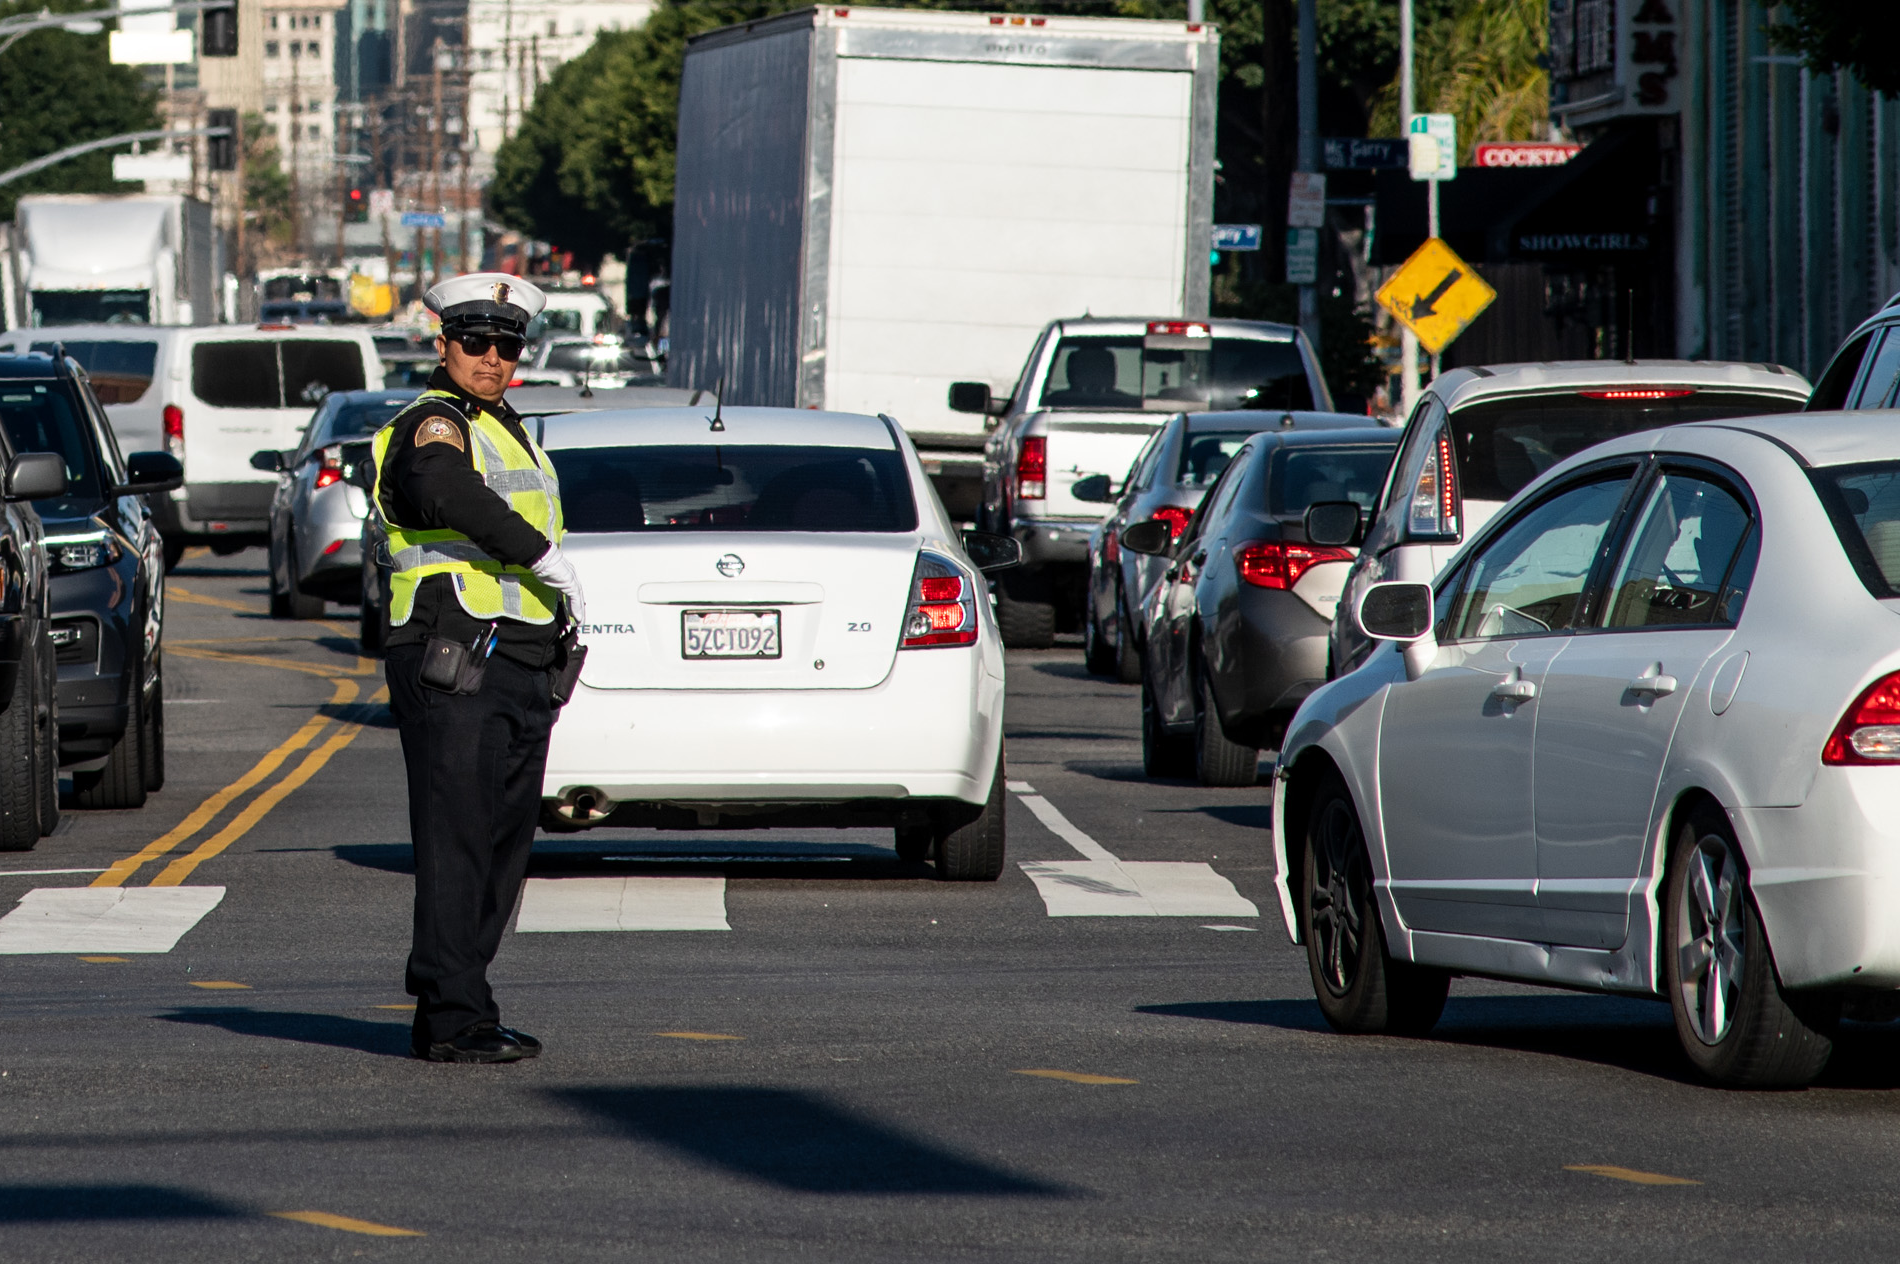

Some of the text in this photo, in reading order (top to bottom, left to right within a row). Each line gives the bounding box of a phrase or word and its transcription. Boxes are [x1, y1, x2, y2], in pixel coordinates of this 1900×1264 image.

[985, 43, 1047, 55] metro
[1519, 233, 1649, 250] SHOWGIRLS
[688, 628, 775, 651] 5ZCT092
